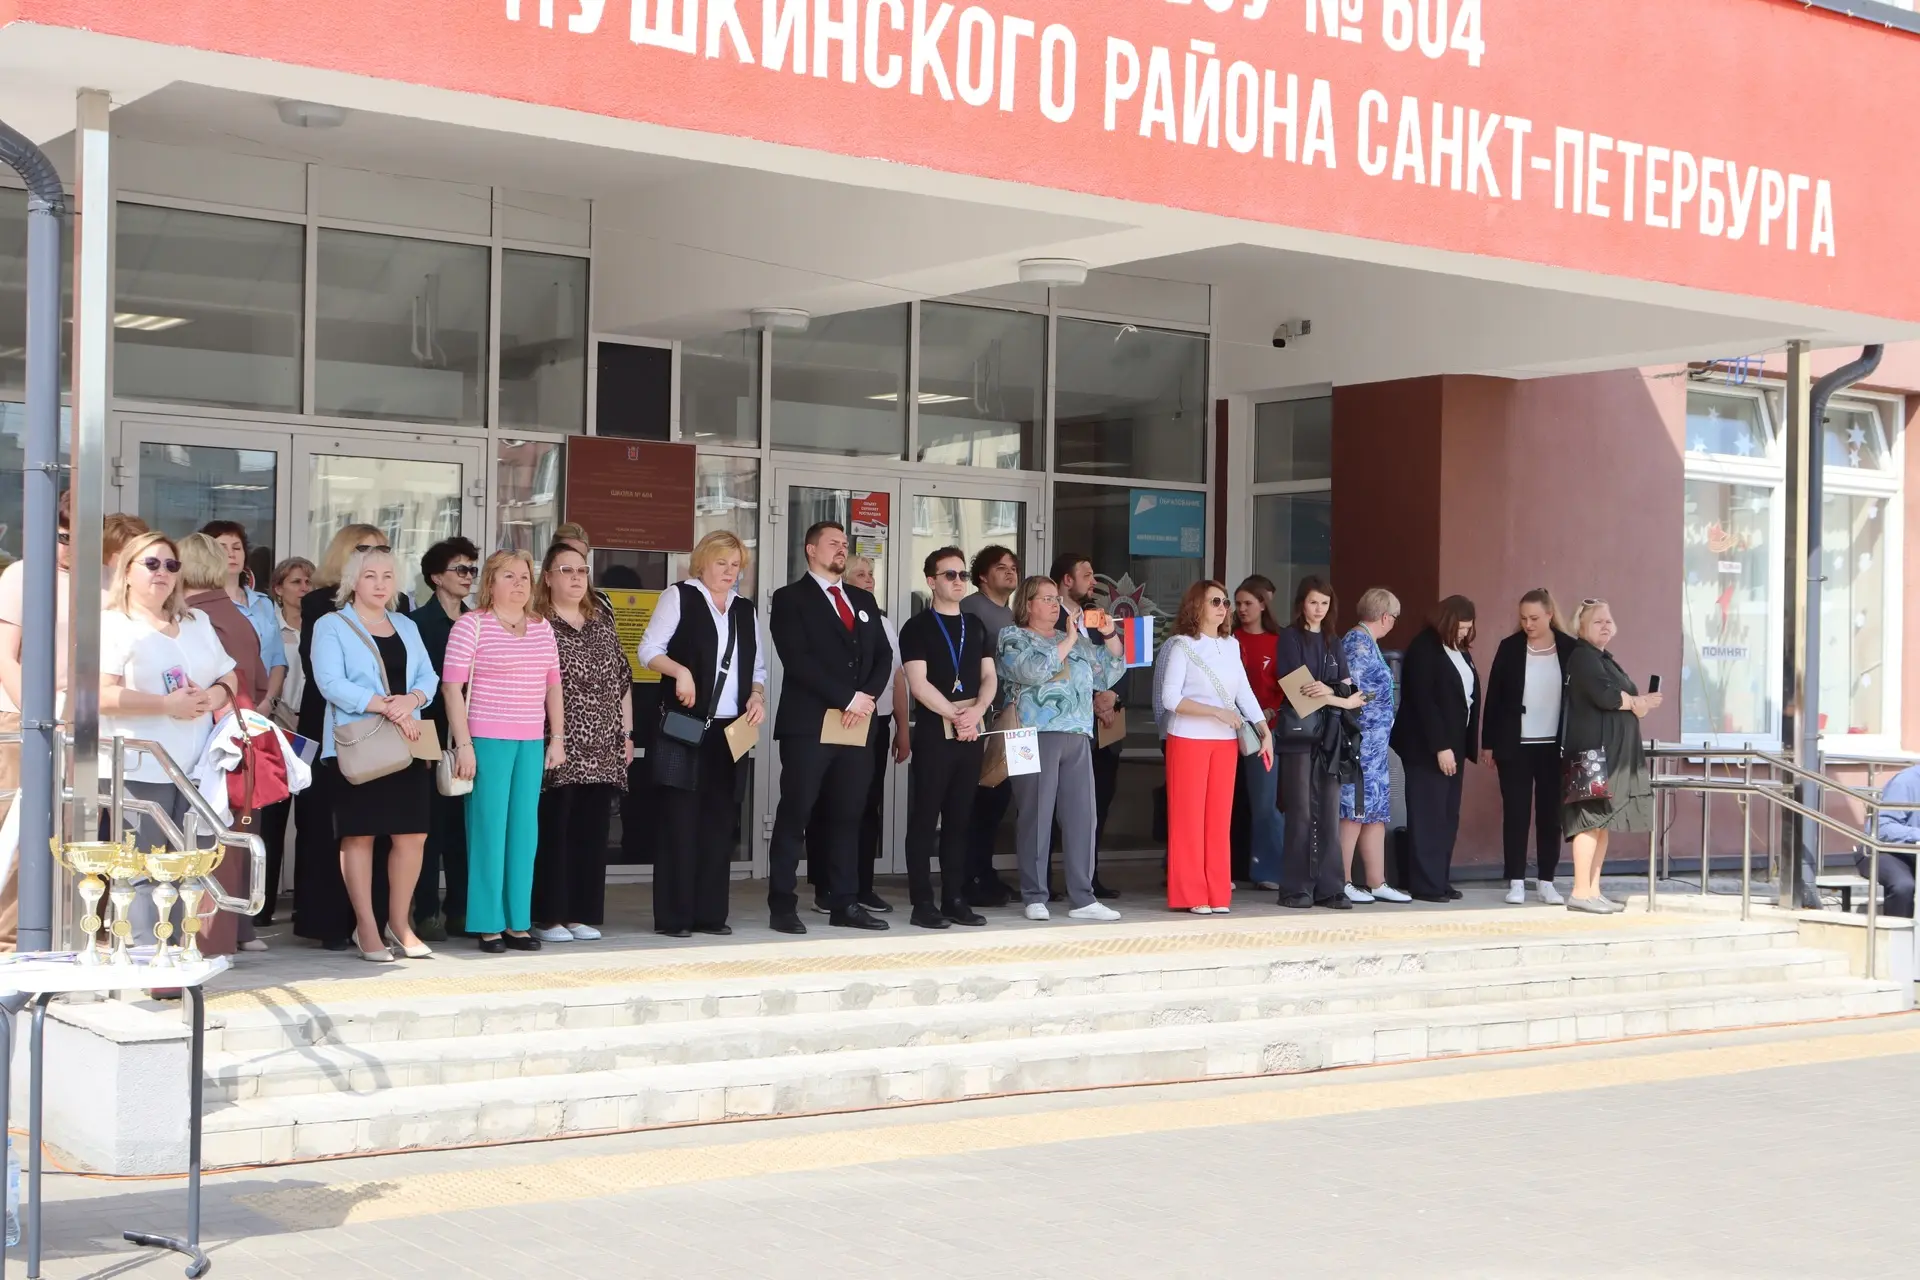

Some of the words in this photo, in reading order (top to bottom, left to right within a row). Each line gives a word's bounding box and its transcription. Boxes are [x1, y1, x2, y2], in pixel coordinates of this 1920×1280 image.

[1382, 0, 1485, 67] 604
[506, 0, 1077, 123] КИНСКОГО
[1104, 37, 1337, 169] РАЙОНА
[1357, 89, 1835, 257] САНКТ-ПЕТЕРБУРГА
[610, 489, 633, 498] ШКОЛА
[1702, 645, 1748, 657] ПОМНЯТ
